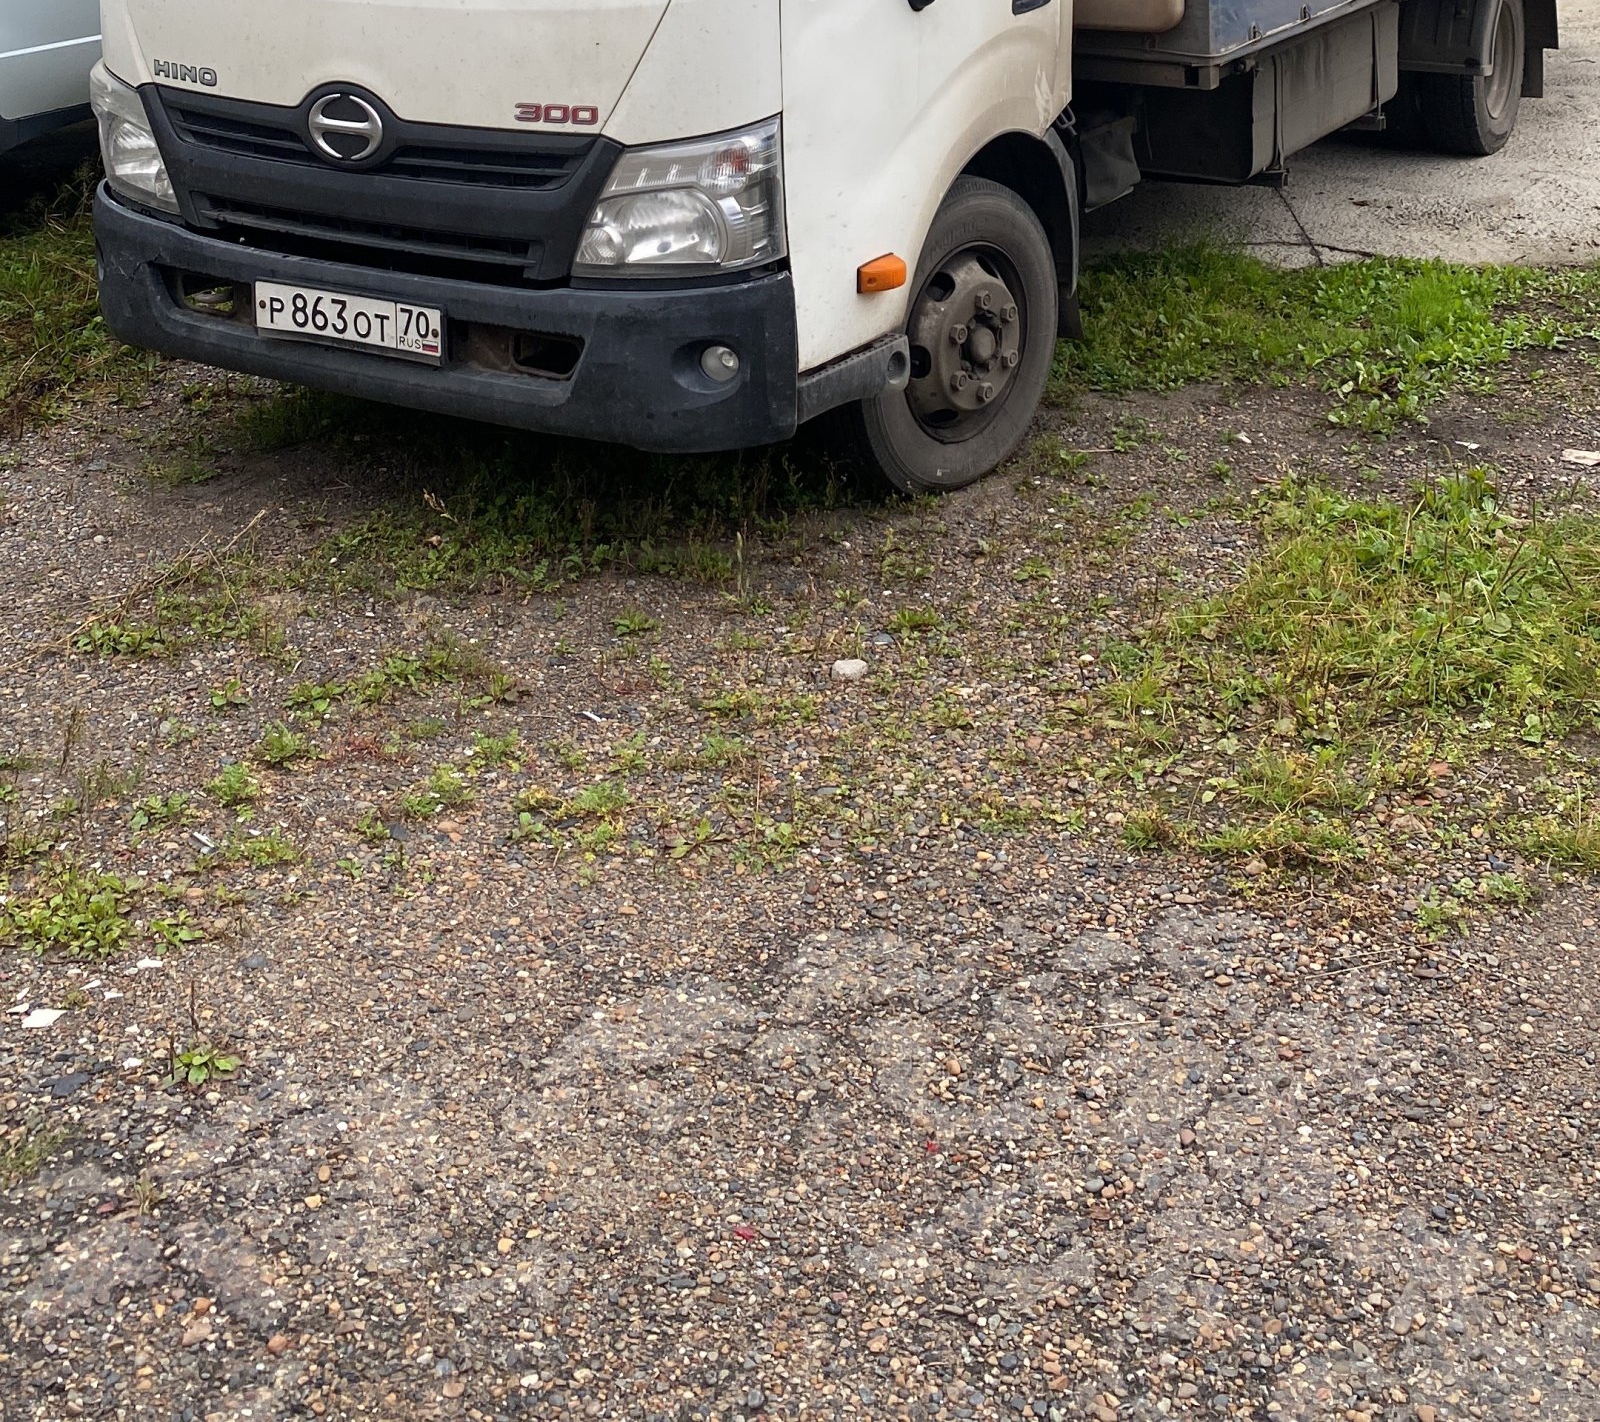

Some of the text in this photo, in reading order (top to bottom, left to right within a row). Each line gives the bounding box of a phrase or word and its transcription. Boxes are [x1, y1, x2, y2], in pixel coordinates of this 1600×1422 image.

[154, 59, 217, 87] HINO
[514, 102, 598, 125] 300
[400, 308, 430, 339] 70
[399, 336, 422, 350] RUS
